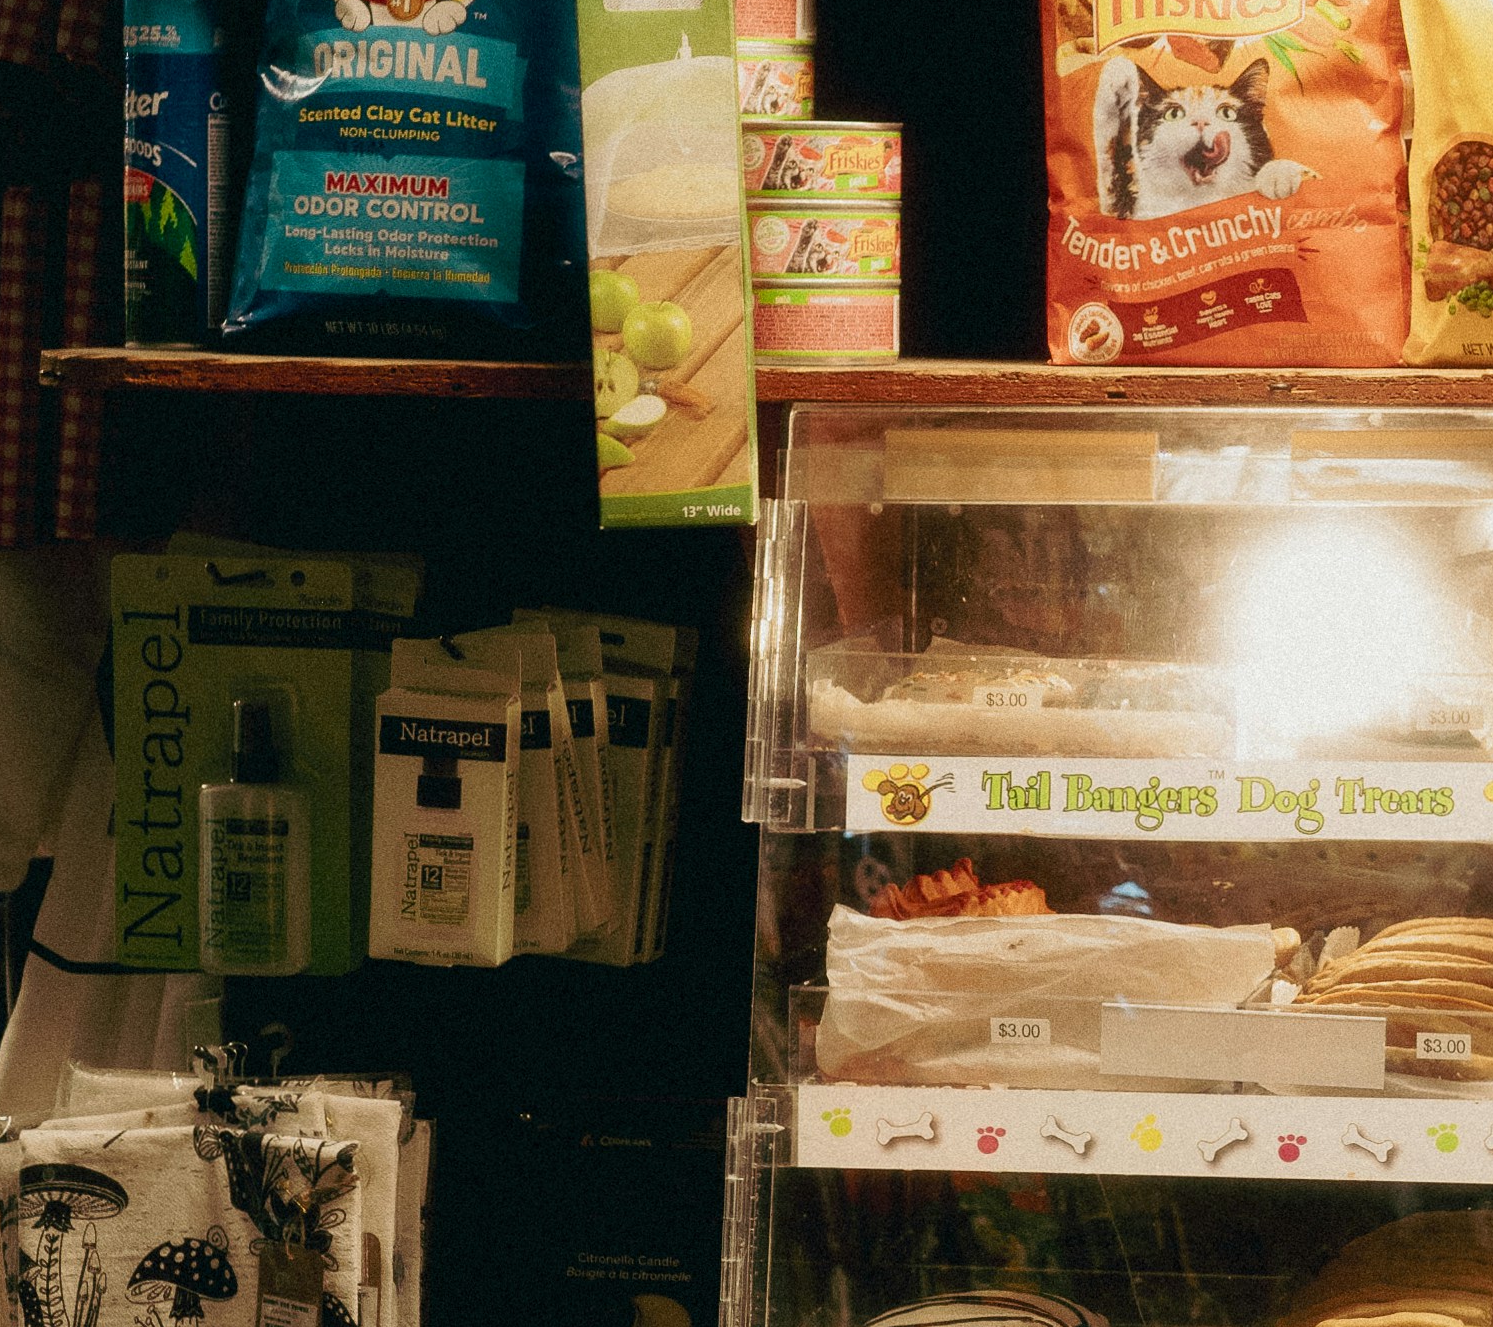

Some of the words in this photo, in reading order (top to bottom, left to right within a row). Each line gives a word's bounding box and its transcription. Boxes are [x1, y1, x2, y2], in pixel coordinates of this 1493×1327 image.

[312, 39, 488, 90] ORIGINAL
[298, 105, 362, 124] Scented
[366, 106, 407, 127] Clay
[408, 105, 441, 124] Cat
[444, 109, 498, 133] Litter
[338, 125, 442, 143] NON-CLUMPING
[829, 153, 882, 173] Friskies
[325, 171, 450, 198] MAXIMUM
[293, 194, 362, 219] ODOR
[366, 197, 486, 225] CONTROL
[284, 223, 373, 244] Long-Lasting
[377, 229, 412, 246] Odor
[416, 231, 499, 250] Protection
[324, 241, 364, 259] Locks
[366, 242, 383, 259] in
[384, 244, 450, 262] Moisture
[199, 610, 255, 631] Family
[258, 610, 343, 631] Protection
[984, 690, 1028, 711] $3.00
[1427, 708, 1472, 728] $3.00
[399, 721, 494, 748] Natrapel
[122, 605, 192, 948] Natrapel
[981, 769, 1052, 812] Tail
[1061, 770, 1218, 833] Bangers
[1236, 774, 1321, 834] Dog
[1333, 773, 1456, 819] Treats
[997, 1022, 1042, 1041] $3.00
[1422, 1038, 1469, 1058] $3.00
[576, 1250, 637, 1269] Citronella
[640, 1253, 681, 1270] Candle
